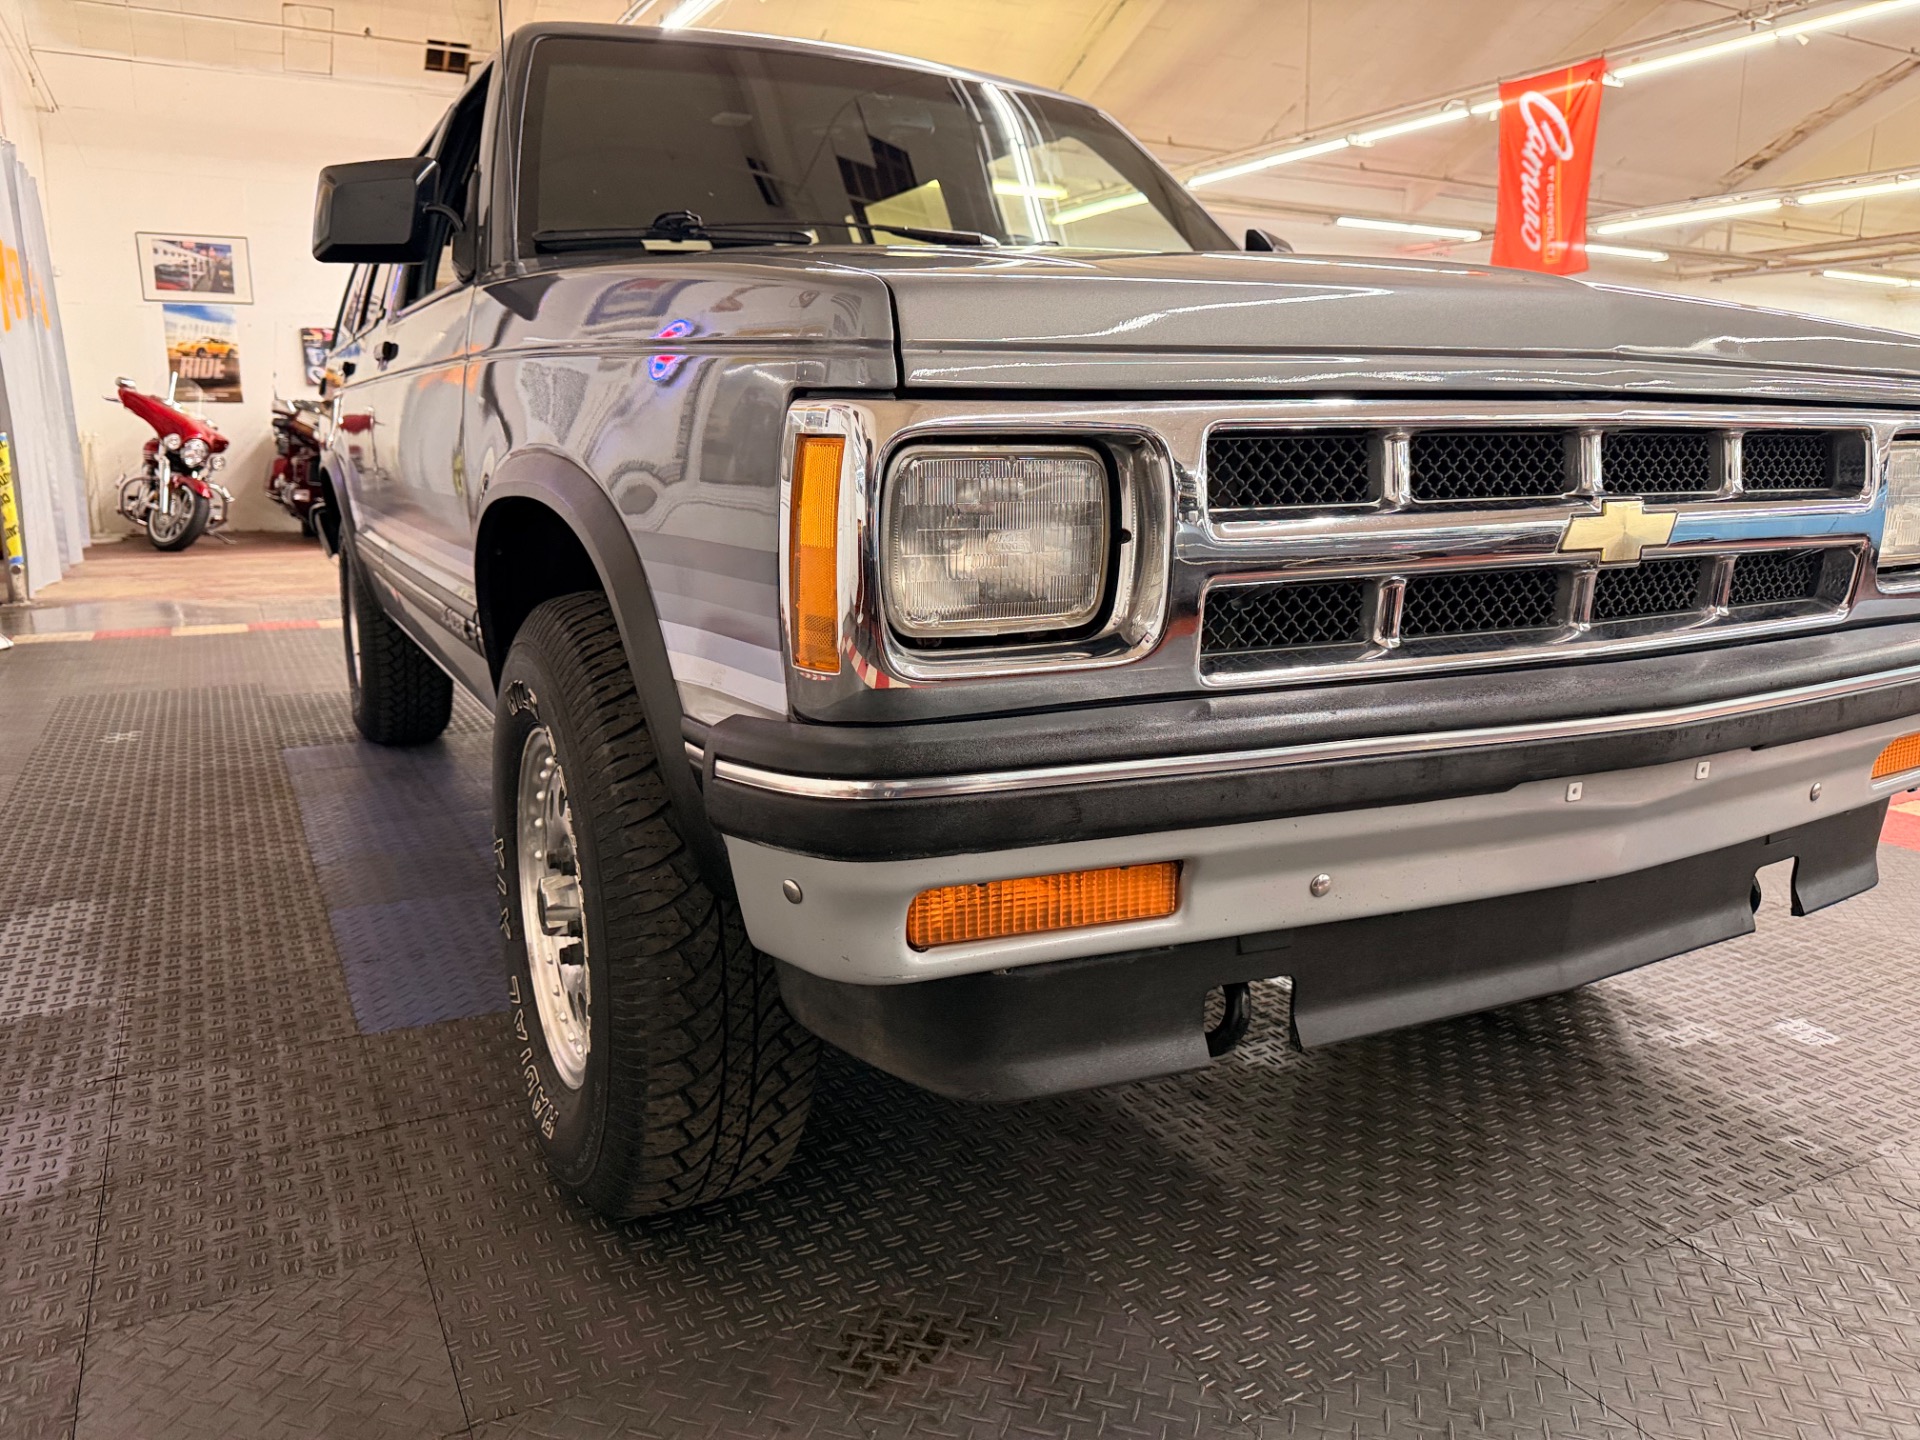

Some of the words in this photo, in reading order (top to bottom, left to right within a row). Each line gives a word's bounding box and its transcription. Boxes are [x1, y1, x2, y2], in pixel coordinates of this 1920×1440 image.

[1519, 90, 1574, 252] Camaro
[179, 357, 226, 380] RIDE
[509, 975, 560, 1140] RADIAL
